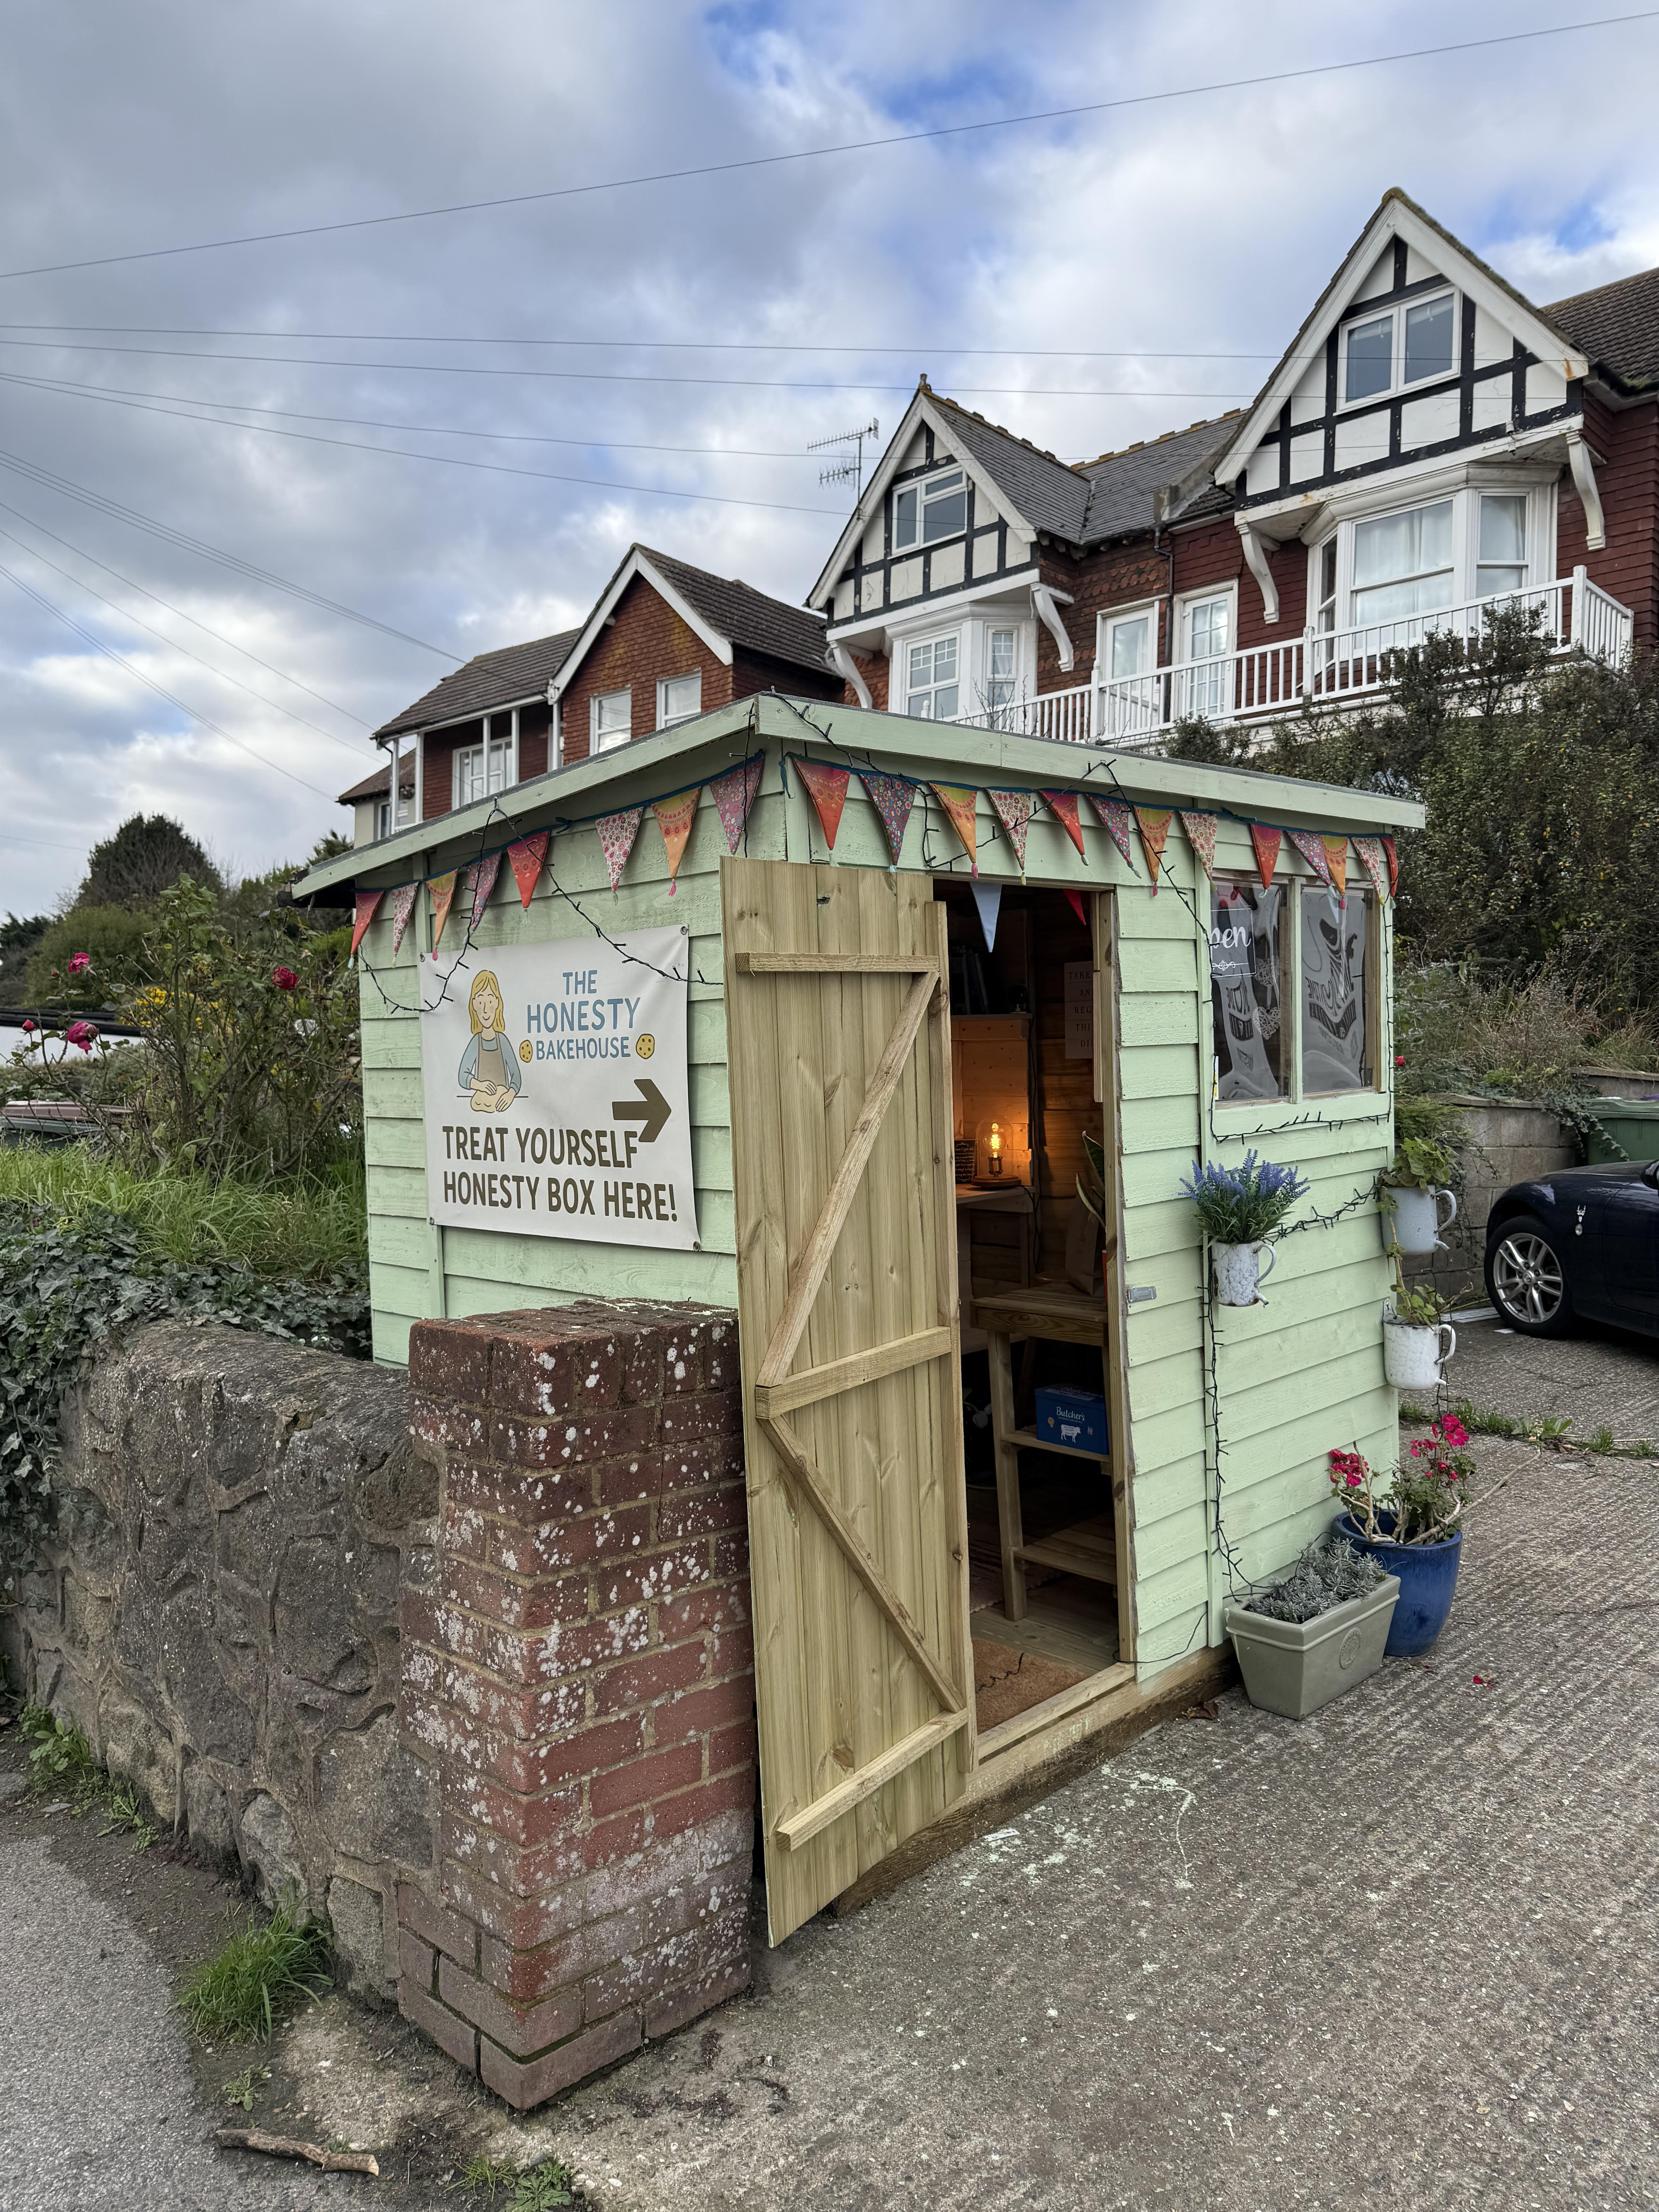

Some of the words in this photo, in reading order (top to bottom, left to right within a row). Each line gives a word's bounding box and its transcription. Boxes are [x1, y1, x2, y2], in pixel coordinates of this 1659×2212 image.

[1211, 927, 1252, 949] pen
[563, 970, 598, 995] THE
[1068, 971, 1091, 979] TAKE
[527, 997, 641, 1033] HONESTY
[536, 1036, 630, 1060] BAKEHOUSE
[442, 1126, 508, 1161] TREAT
[515, 1127, 637, 1168] YOURSELF
[443, 1171, 540, 1210] HONESTY
[548, 1177, 595, 1215] BOX
[604, 1180, 678, 1222] HERE!
[1056, 1406, 1085, 1421] Butcher's
